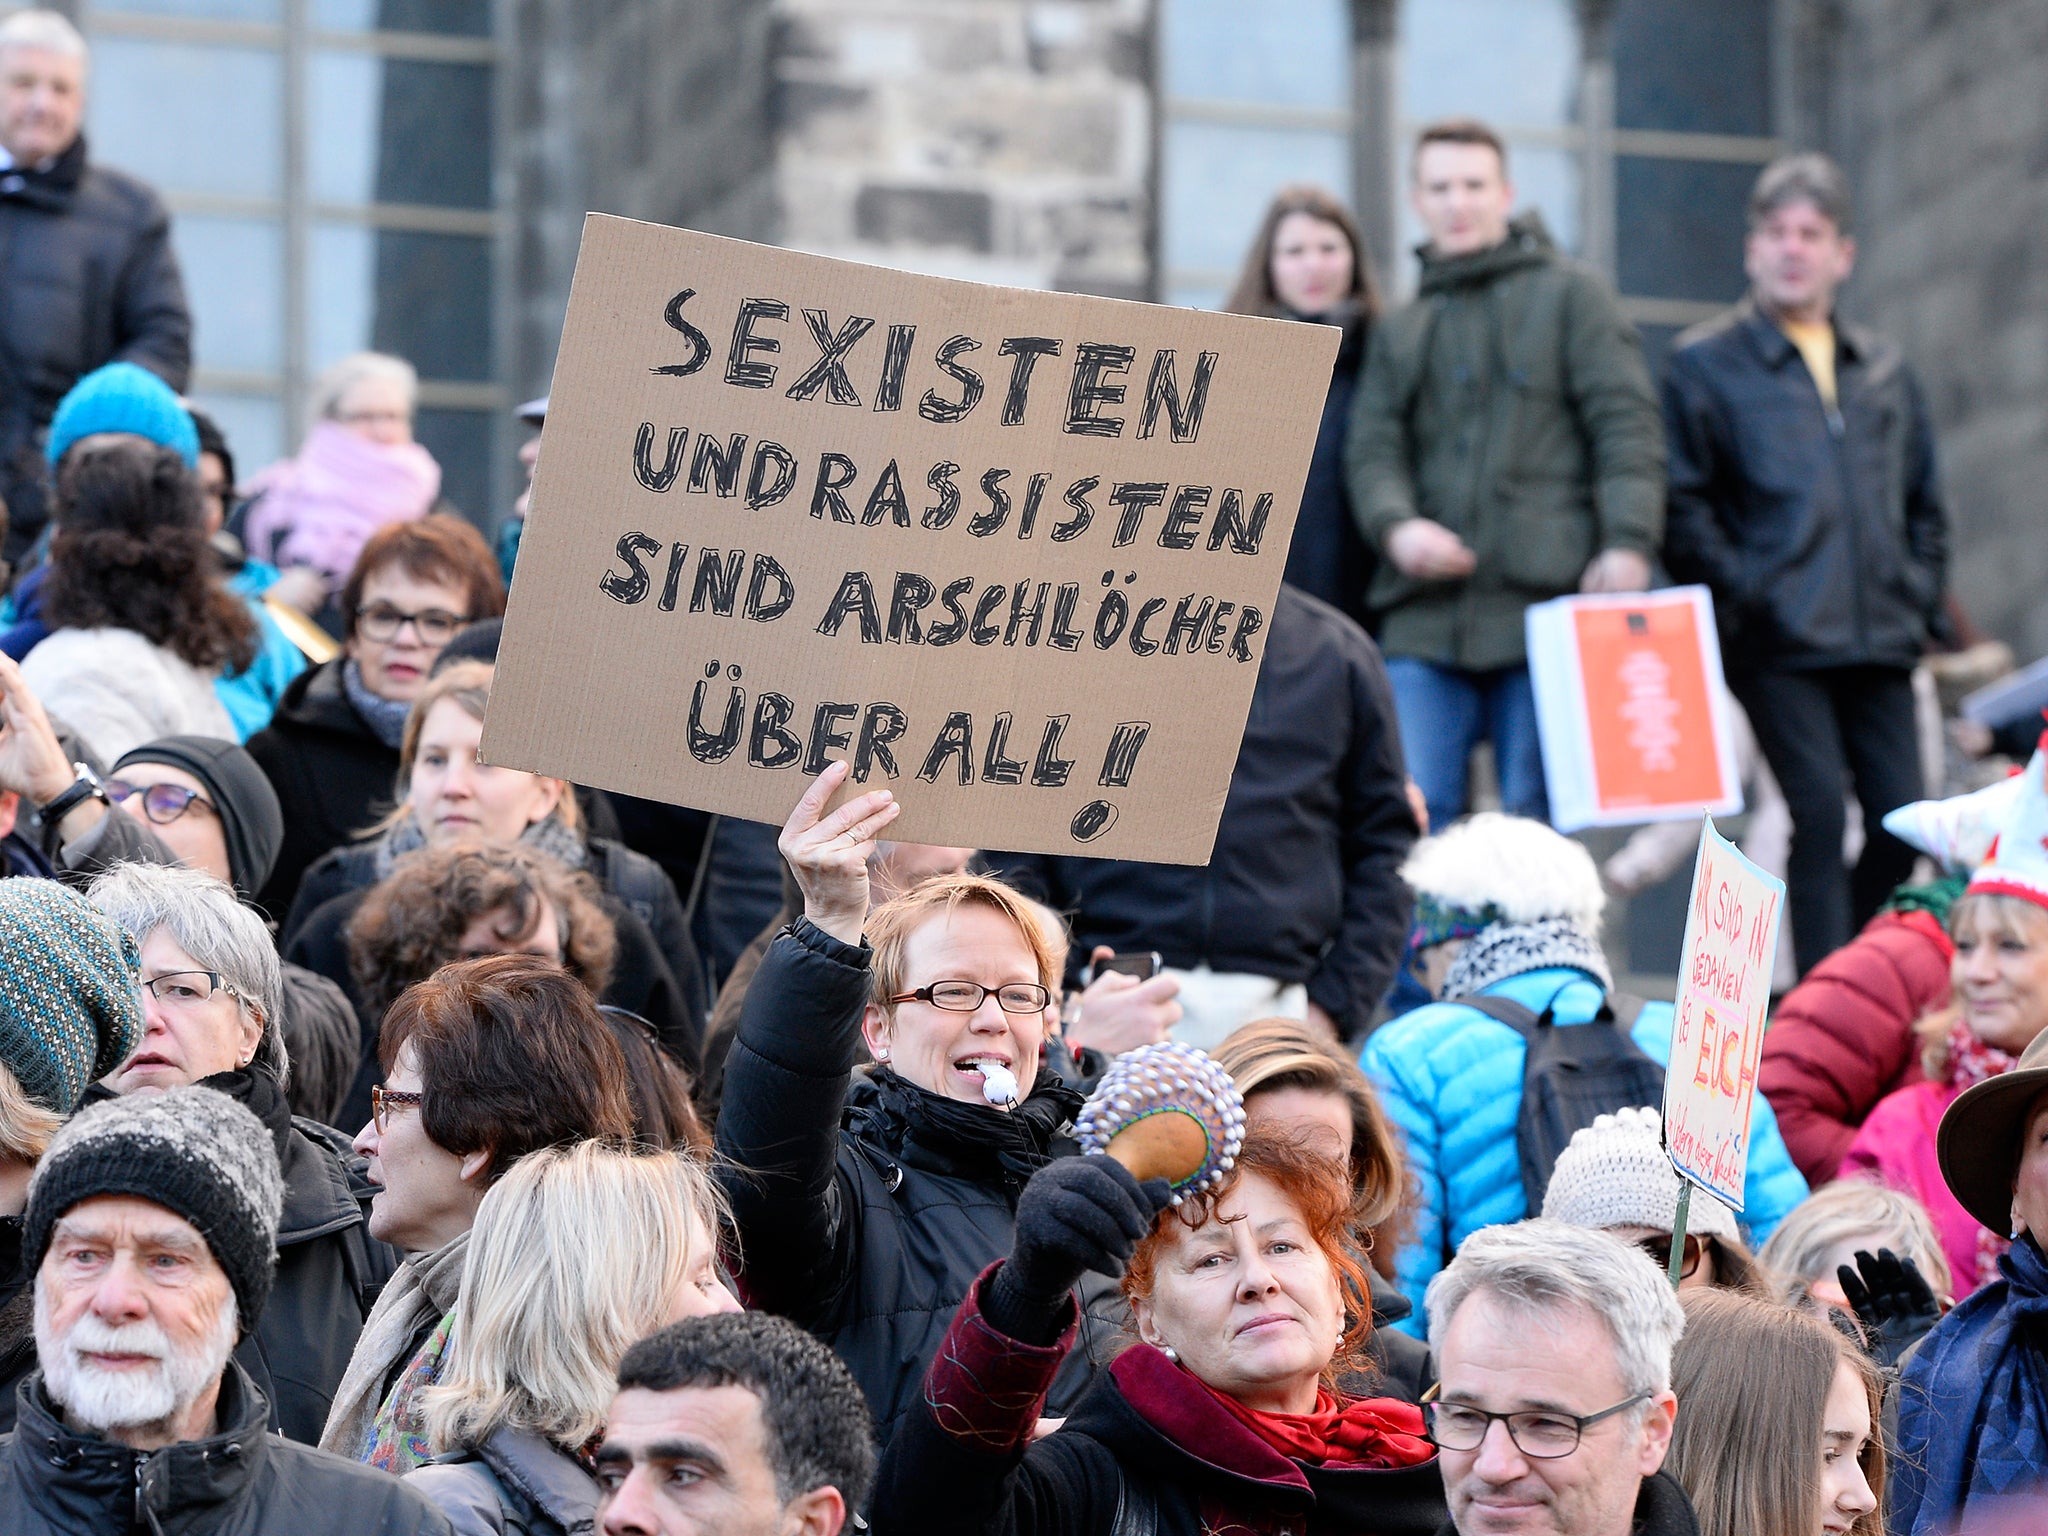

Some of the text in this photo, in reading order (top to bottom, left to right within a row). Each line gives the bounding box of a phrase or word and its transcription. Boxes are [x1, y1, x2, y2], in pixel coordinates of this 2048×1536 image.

[648, 287, 1220, 444] SEXISTEN
[599, 531, 1264, 664] SIND ARSCHLÖCHER
[1713, 880, 1744, 946] SIND
[1748, 891, 1777, 970] IN
[1692, 1003, 1765, 1147] EUCH
